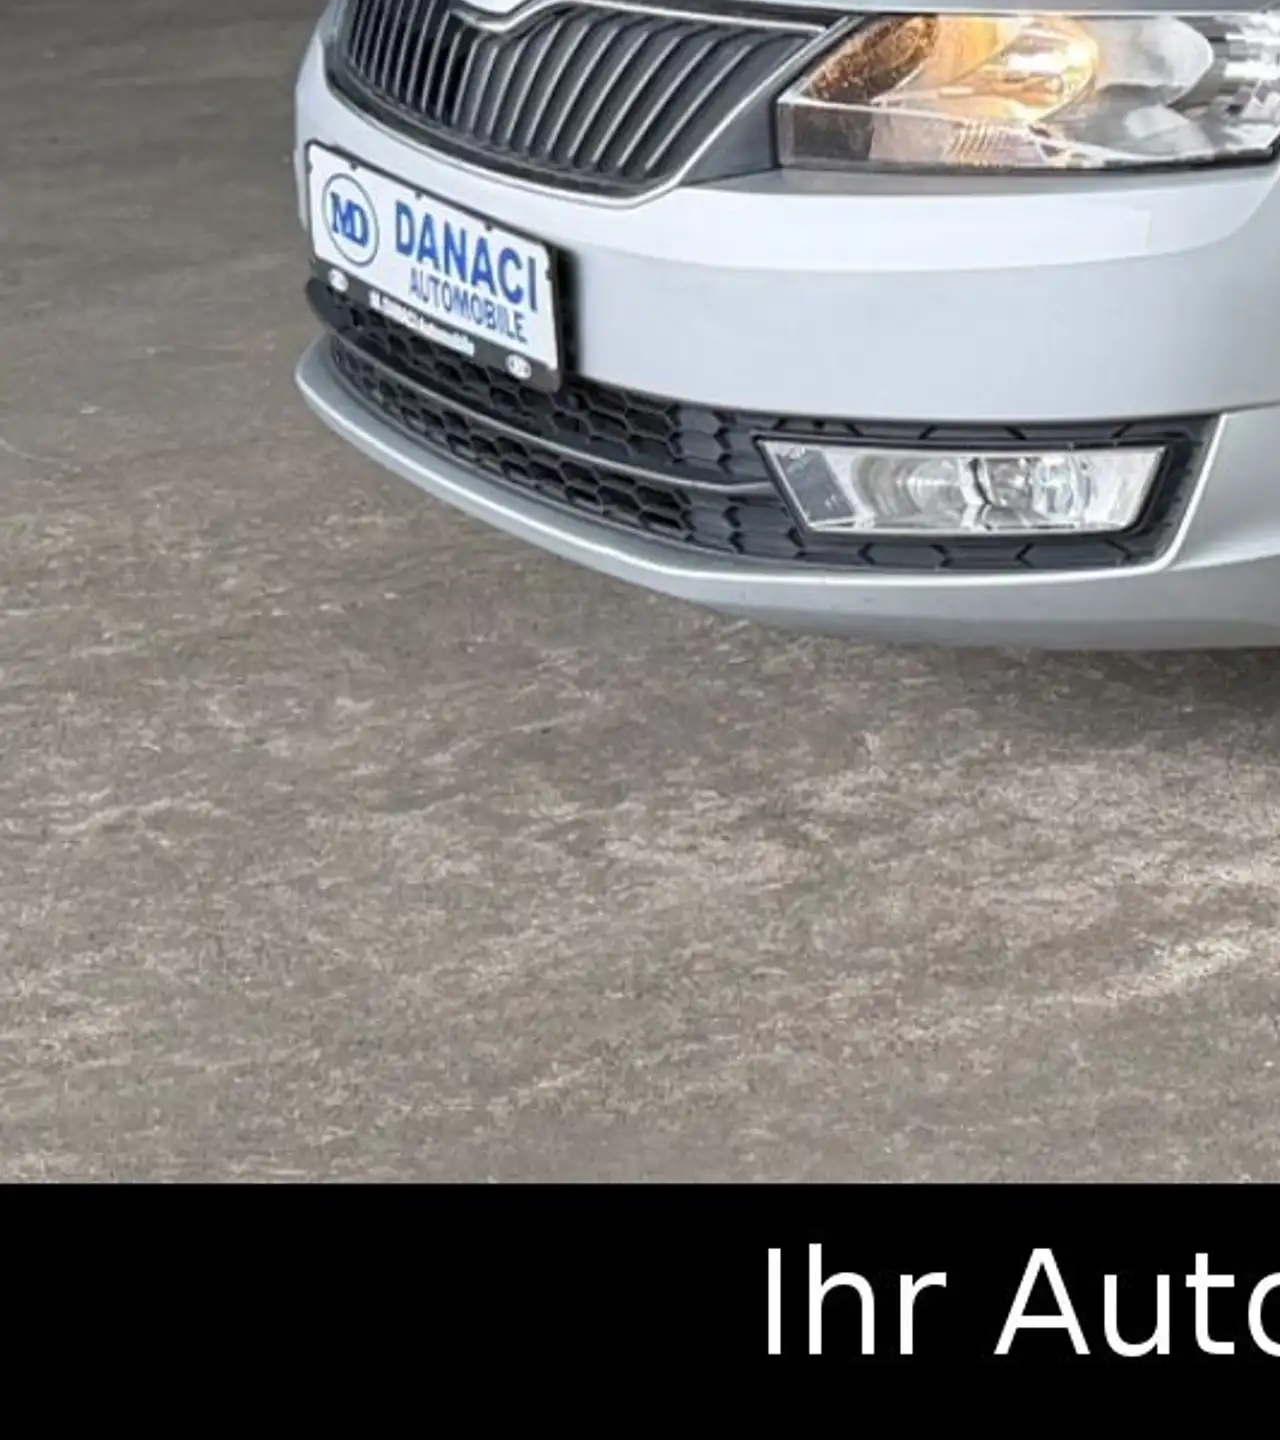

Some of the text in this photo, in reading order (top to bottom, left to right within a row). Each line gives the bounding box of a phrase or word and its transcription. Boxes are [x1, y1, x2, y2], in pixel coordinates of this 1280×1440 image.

[329, 191, 370, 248] MD
[395, 200, 538, 312] DANACI
[409, 268, 528, 344] AUTOMOBILE
